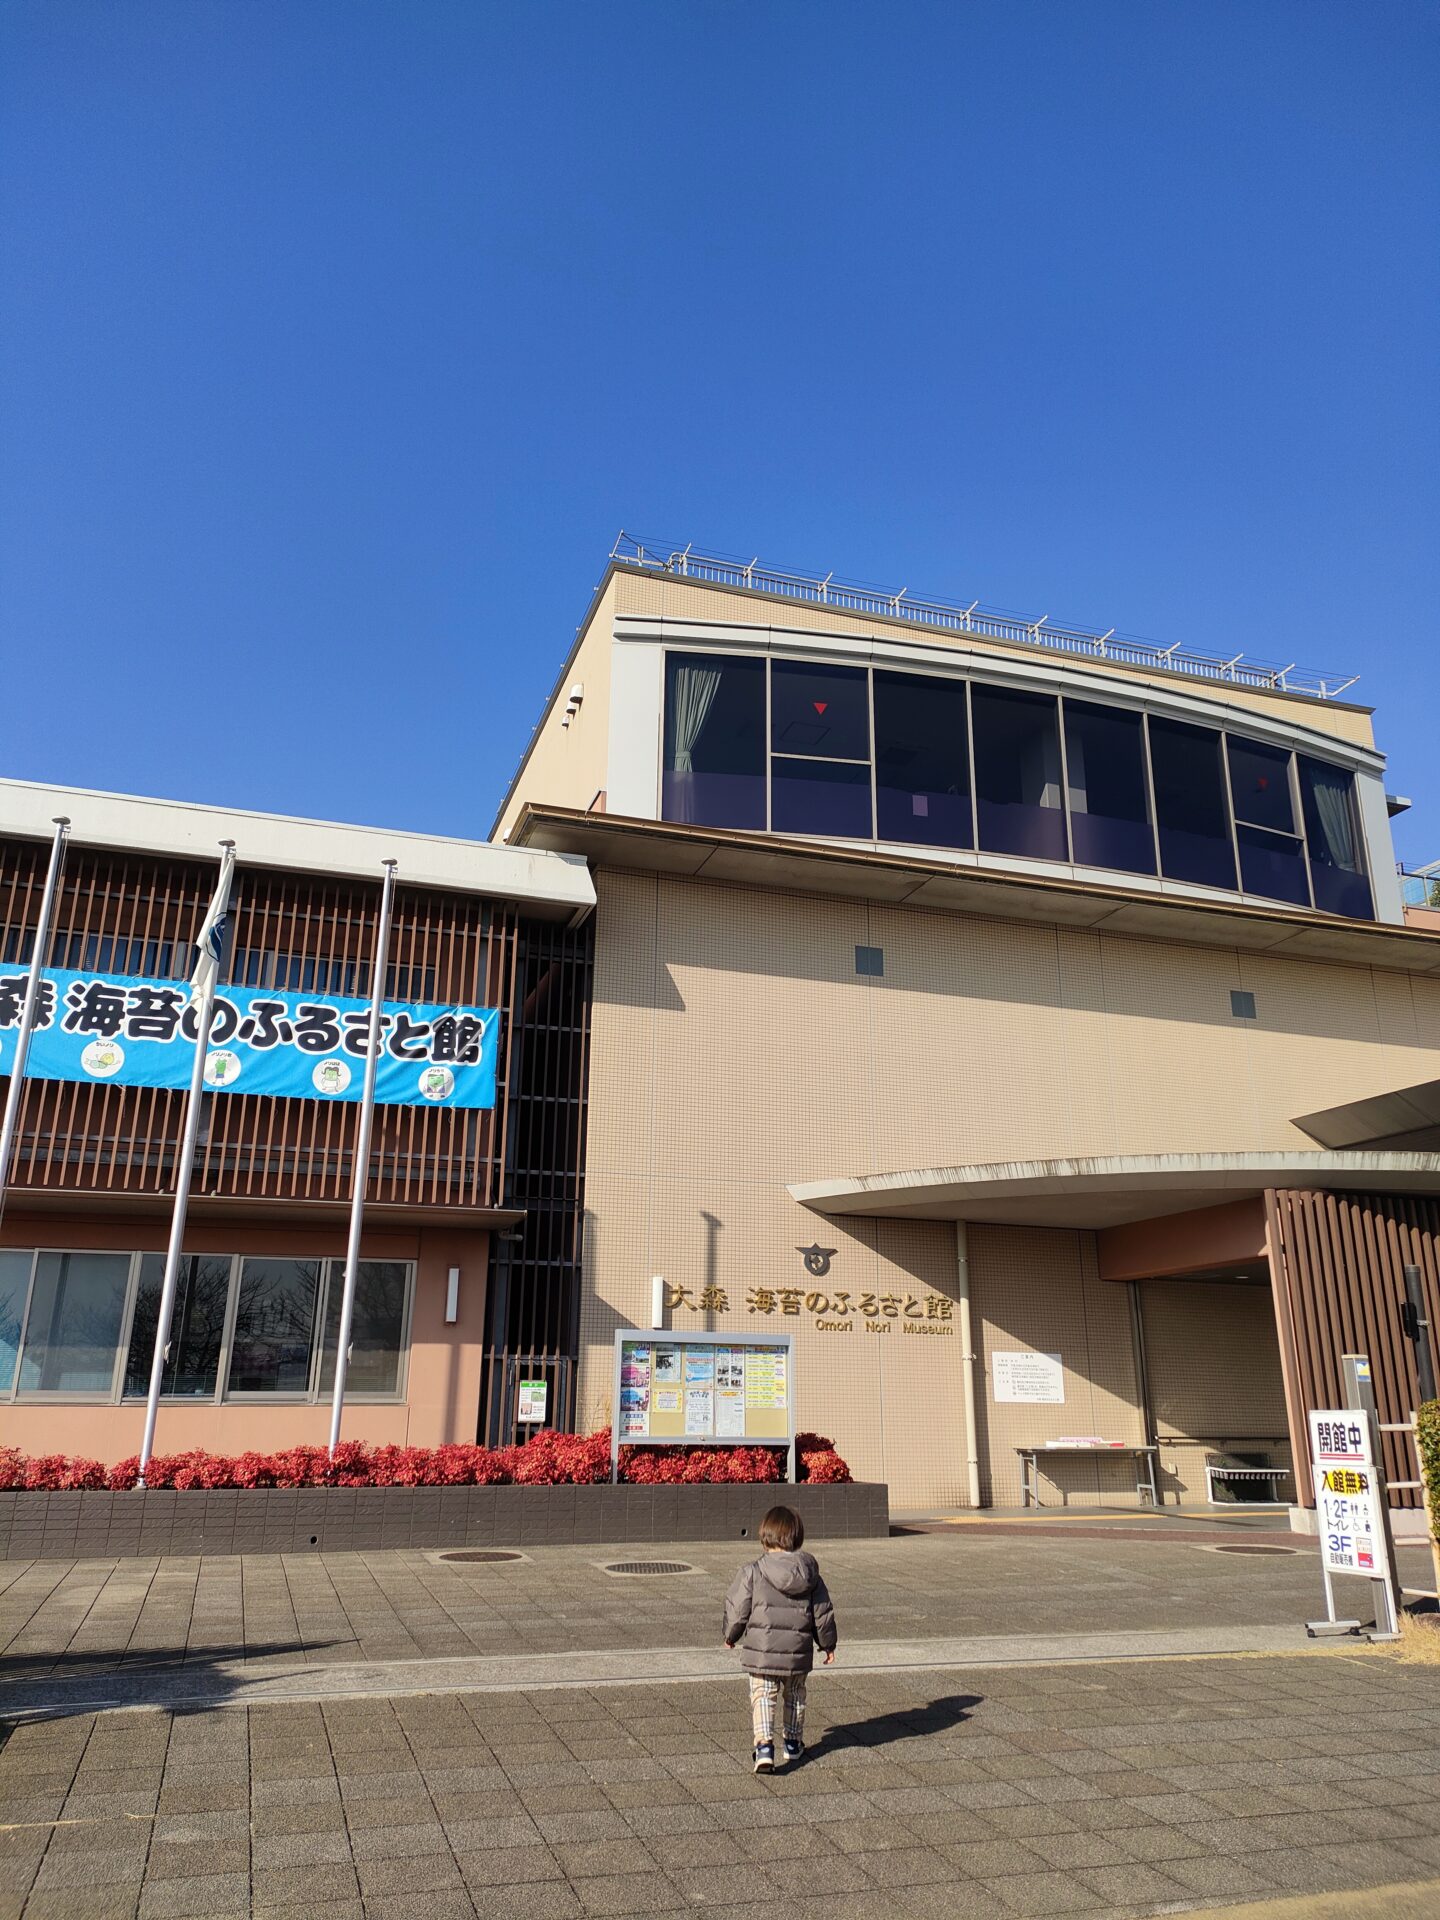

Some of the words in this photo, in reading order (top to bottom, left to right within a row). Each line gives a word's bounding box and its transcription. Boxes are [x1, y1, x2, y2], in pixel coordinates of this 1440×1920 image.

[664, 1283, 730, 1314] 大森
[745, 1286, 953, 1321] 海苔のふるさと館
[815, 1319, 853, 1332] Omori
[865, 1321, 891, 1333] Nori
[902, 1322, 954, 1336] Museum
[1317, 1421, 1362, 1453] 開館中
[1321, 1470, 1370, 1495] 入館無料
[1327, 1519, 1349, 1531] トイレ
[1328, 1534, 1352, 1552] 3F
